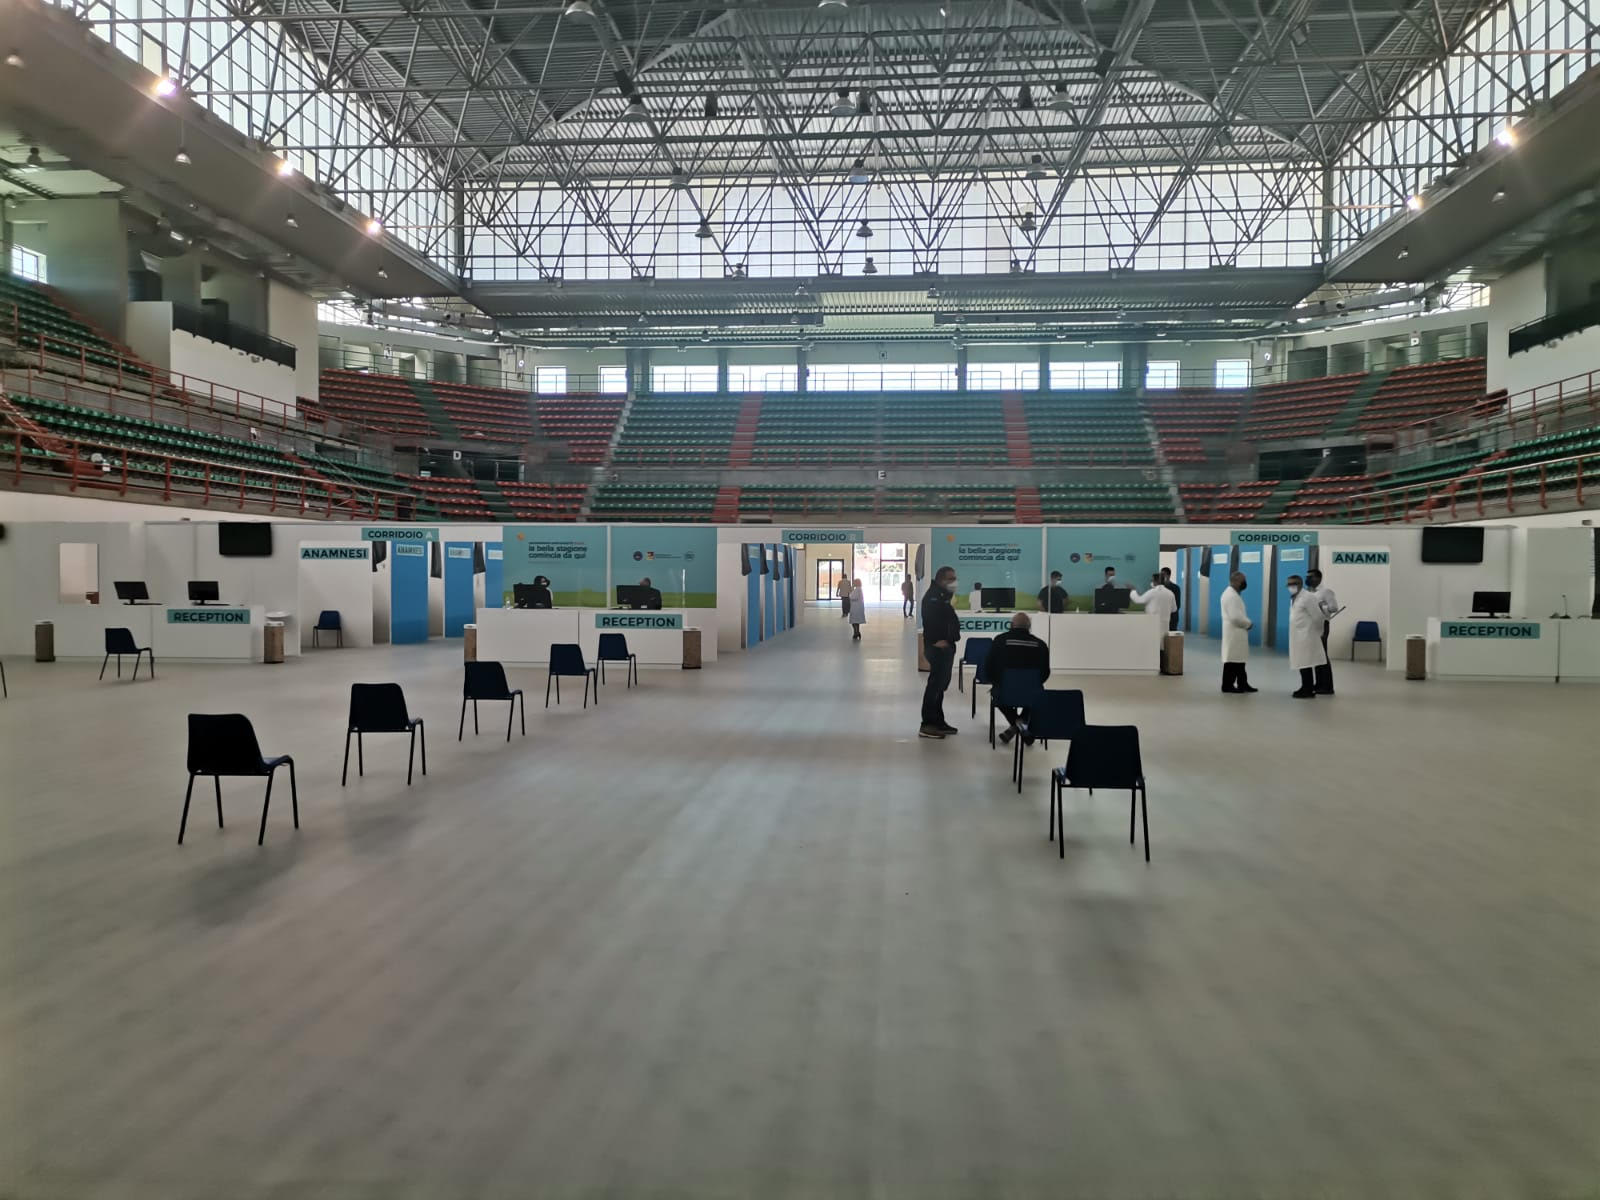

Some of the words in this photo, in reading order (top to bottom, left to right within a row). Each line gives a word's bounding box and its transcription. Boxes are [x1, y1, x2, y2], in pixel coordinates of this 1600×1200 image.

[453, 451, 462, 460] D
[878, 470, 887, 480] E
[368, 530, 423, 539] CORRIDOIO
[425, 531, 433, 539] A
[788, 533, 846, 541] CORRIDOIO
[1238, 534, 1301, 543] CORRIDOIO
[1302, 534, 1311, 542] C
[302, 549, 367, 559] ANAMNESI
[556, 545, 587, 554] stagione
[988, 547, 1021, 556] stagione
[1334, 553, 1387, 563] ANAMN
[173, 612, 244, 622] RECEPTION
[602, 617, 676, 627] RECEPTION
[960, 620, 1013, 631] ECEPTIO
[1448, 625, 1532, 637] RECEPTION
